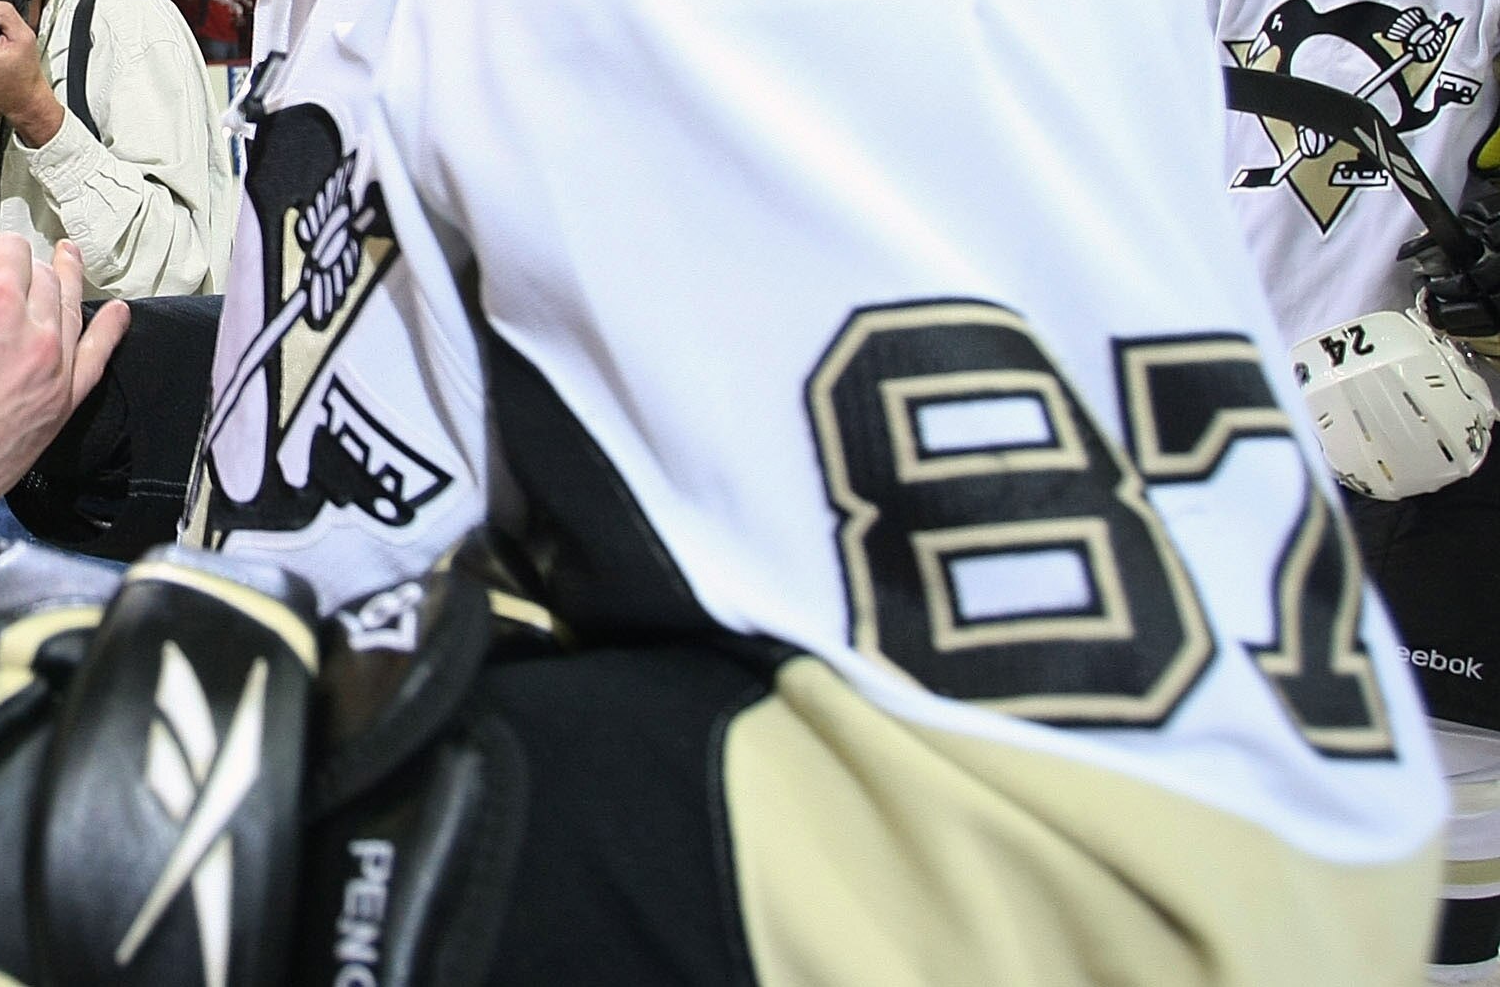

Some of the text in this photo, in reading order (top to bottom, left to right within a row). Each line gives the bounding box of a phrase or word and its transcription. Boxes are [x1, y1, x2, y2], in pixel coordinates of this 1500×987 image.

[1318, 324, 1375, 367] 24
[803, 297, 1400, 763] 87
[1396, 645, 1484, 680] eebok
